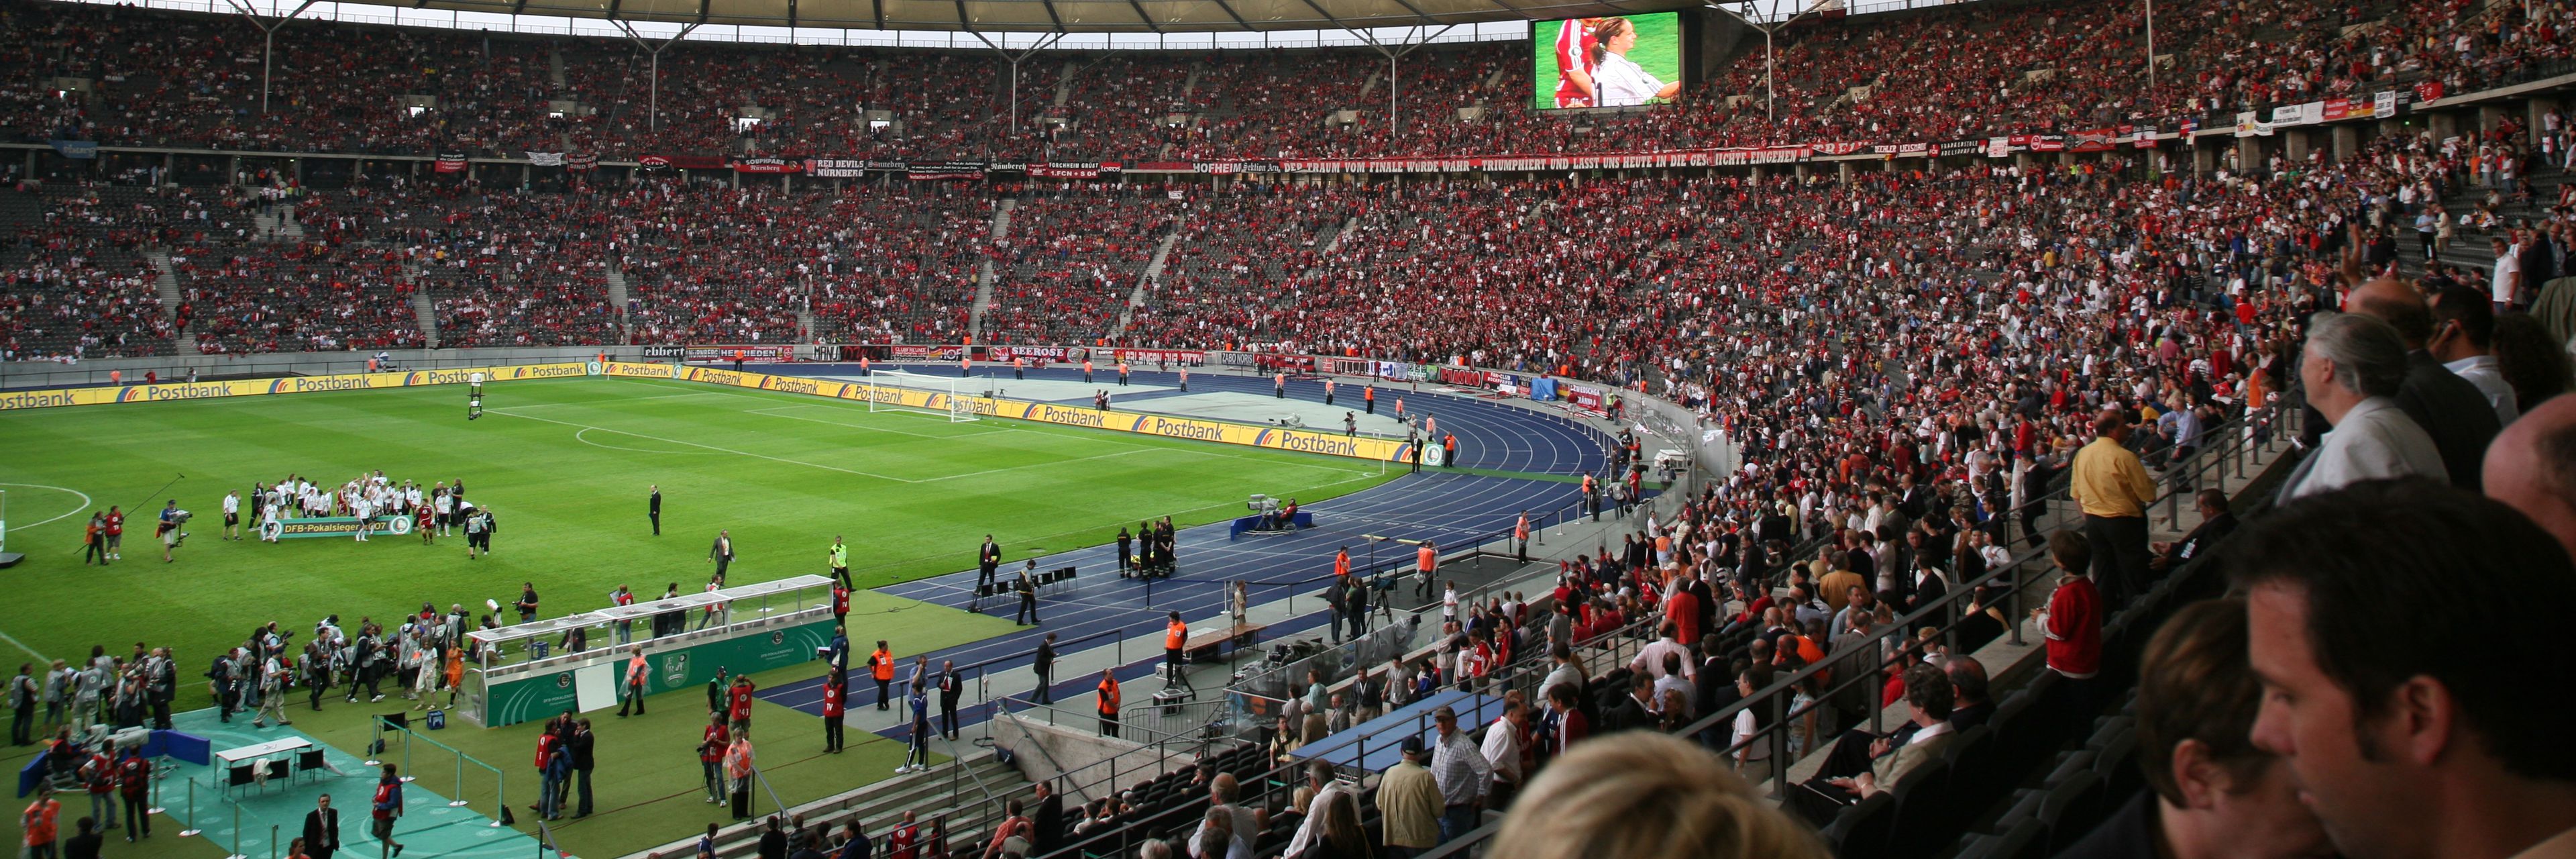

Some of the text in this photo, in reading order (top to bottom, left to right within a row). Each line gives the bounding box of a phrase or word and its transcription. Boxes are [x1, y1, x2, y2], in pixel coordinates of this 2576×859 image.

[817, 160, 864, 168] RED DEVILS
[1193, 163, 1242, 173] HOFHEIM
[1306, 162, 1340, 173] TRAUM
[1344, 162, 1365, 173] VOM
[1369, 161, 1403, 172] FINALE
[1406, 161, 1439, 172] WURDE
[1442, 160, 1470, 172] WAHR
[1481, 158, 1546, 171] TRIUMPHIERT
[1550, 158, 1569, 170] UND
[1572, 156, 1600, 169] LASST
[1603, 156, 1620, 168] UNS
[1622, 156, 1652, 168] HEUTE
[1656, 154, 1667, 167] IN
[1670, 154, 1687, 167] DIE
[1750, 150, 1797, 164] EINGEHEN
[817, 168, 863, 177] NÜRNBERG
[1011, 346, 1064, 357] SEEROSE
[1222, 353, 1252, 364] ZABO NORIS
[429, 366, 496, 384] Postbnk
[533, 362, 583, 377] Postbank
[623, 364, 669, 376] Postbank
[702, 369, 743, 385] Postbank
[149, 381, 232, 400] Postbank
[297, 373, 372, 391] Postbank
[775, 377, 819, 395] Postbank
[855, 385, 904, 405] Postbank
[1044, 405, 1105, 426] Postbank
[1156, 418, 1222, 440] Postbank
[1281, 432, 1358, 456] Postbank
[284, 522, 386, 534] DFB-Pokalsieger 007
